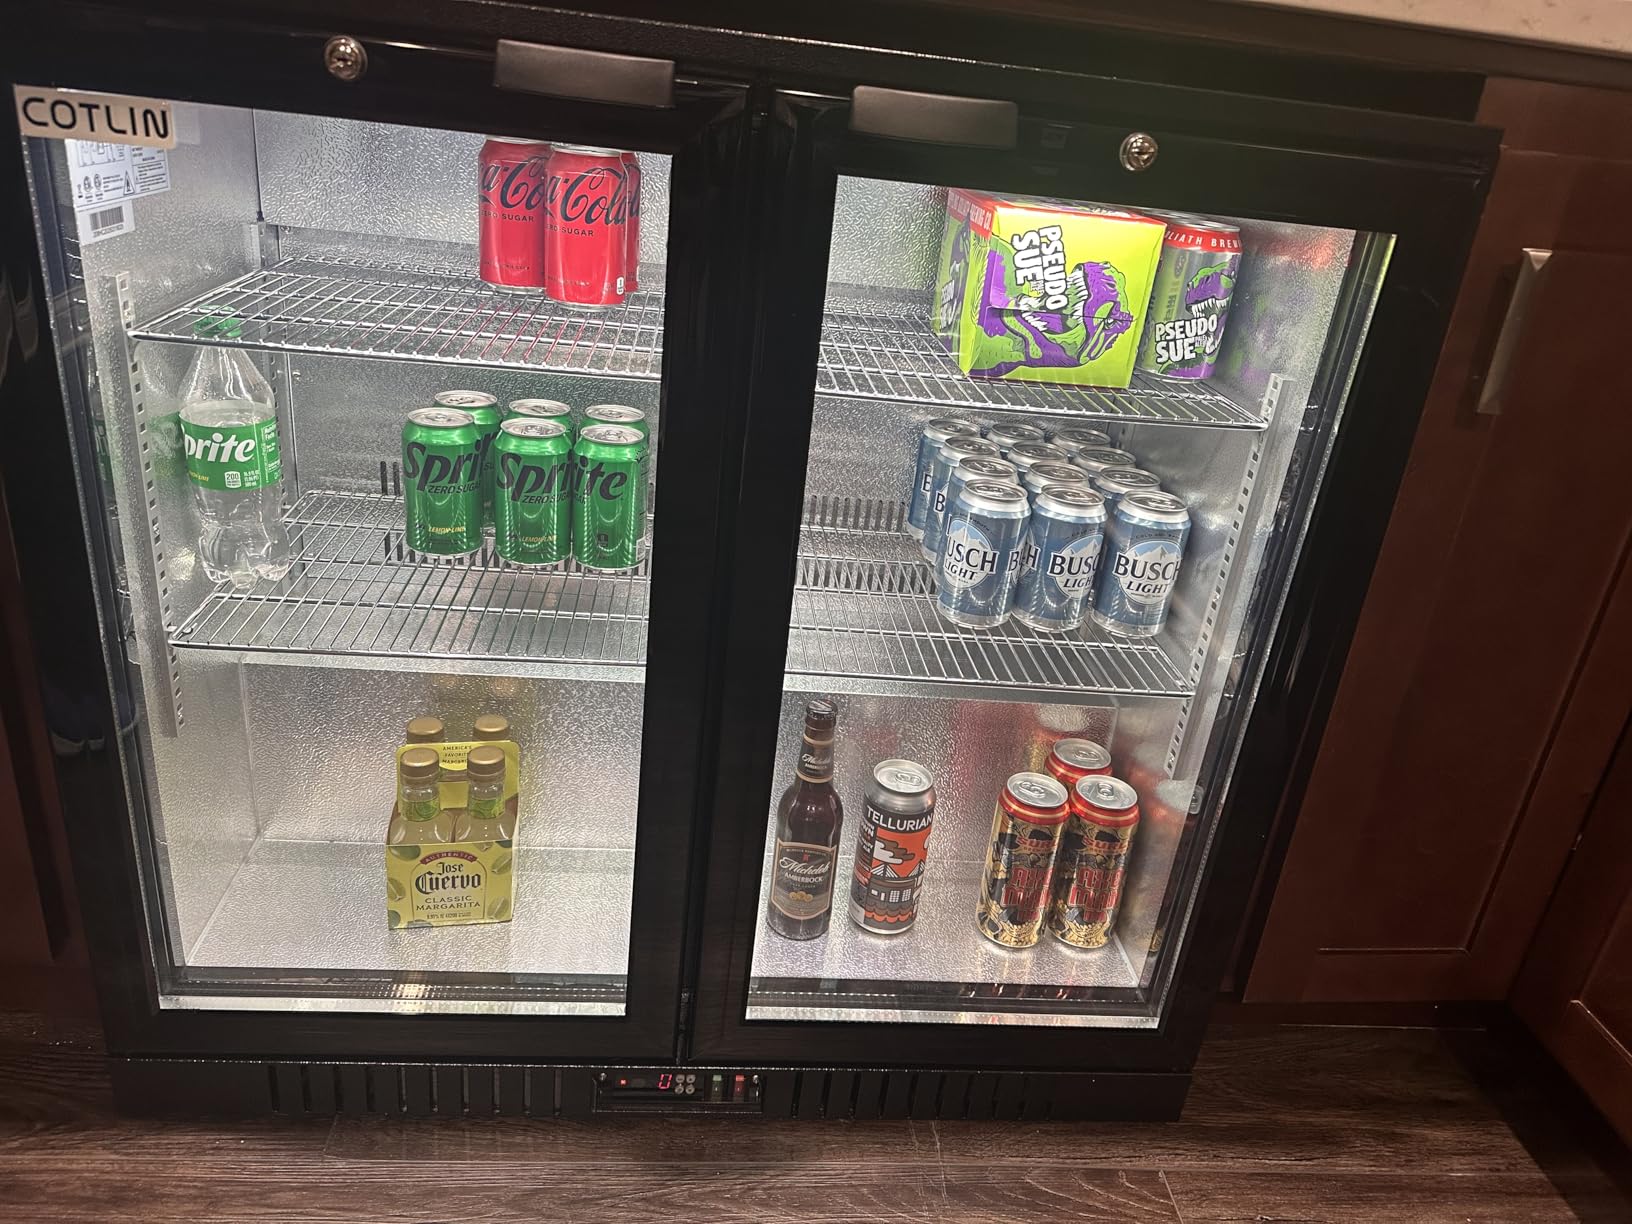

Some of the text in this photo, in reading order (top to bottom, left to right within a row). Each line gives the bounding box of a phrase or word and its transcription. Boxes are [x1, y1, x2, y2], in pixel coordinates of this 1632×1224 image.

[22, 96, 169, 138] COTLIN
[501, 213, 534, 222] SUGAR
[561, 226, 594, 236] SUGAR
[1011, 230, 1044, 286] SUE
[1039, 225, 1069, 310] PSEUDO
[1155, 314, 1218, 342] PSEUDO
[1155, 338, 1197, 364] SUE
[181, 423, 256, 463] prite
[427, 485, 455, 494] ZERO
[522, 495, 549, 504] ZERO
[1114, 553, 1181, 582] BUSCH
[1126, 580, 1170, 594] LIGHT
[866, 805, 933, 831] TELLURIAN
[424, 852, 474, 863] AUTHENTIC
[436, 862, 464, 876] Jose
[415, 870, 481, 895] Cuervo
[416, 901, 481, 911] MARGARITA
[424, 895, 472, 904] CLASSIC
